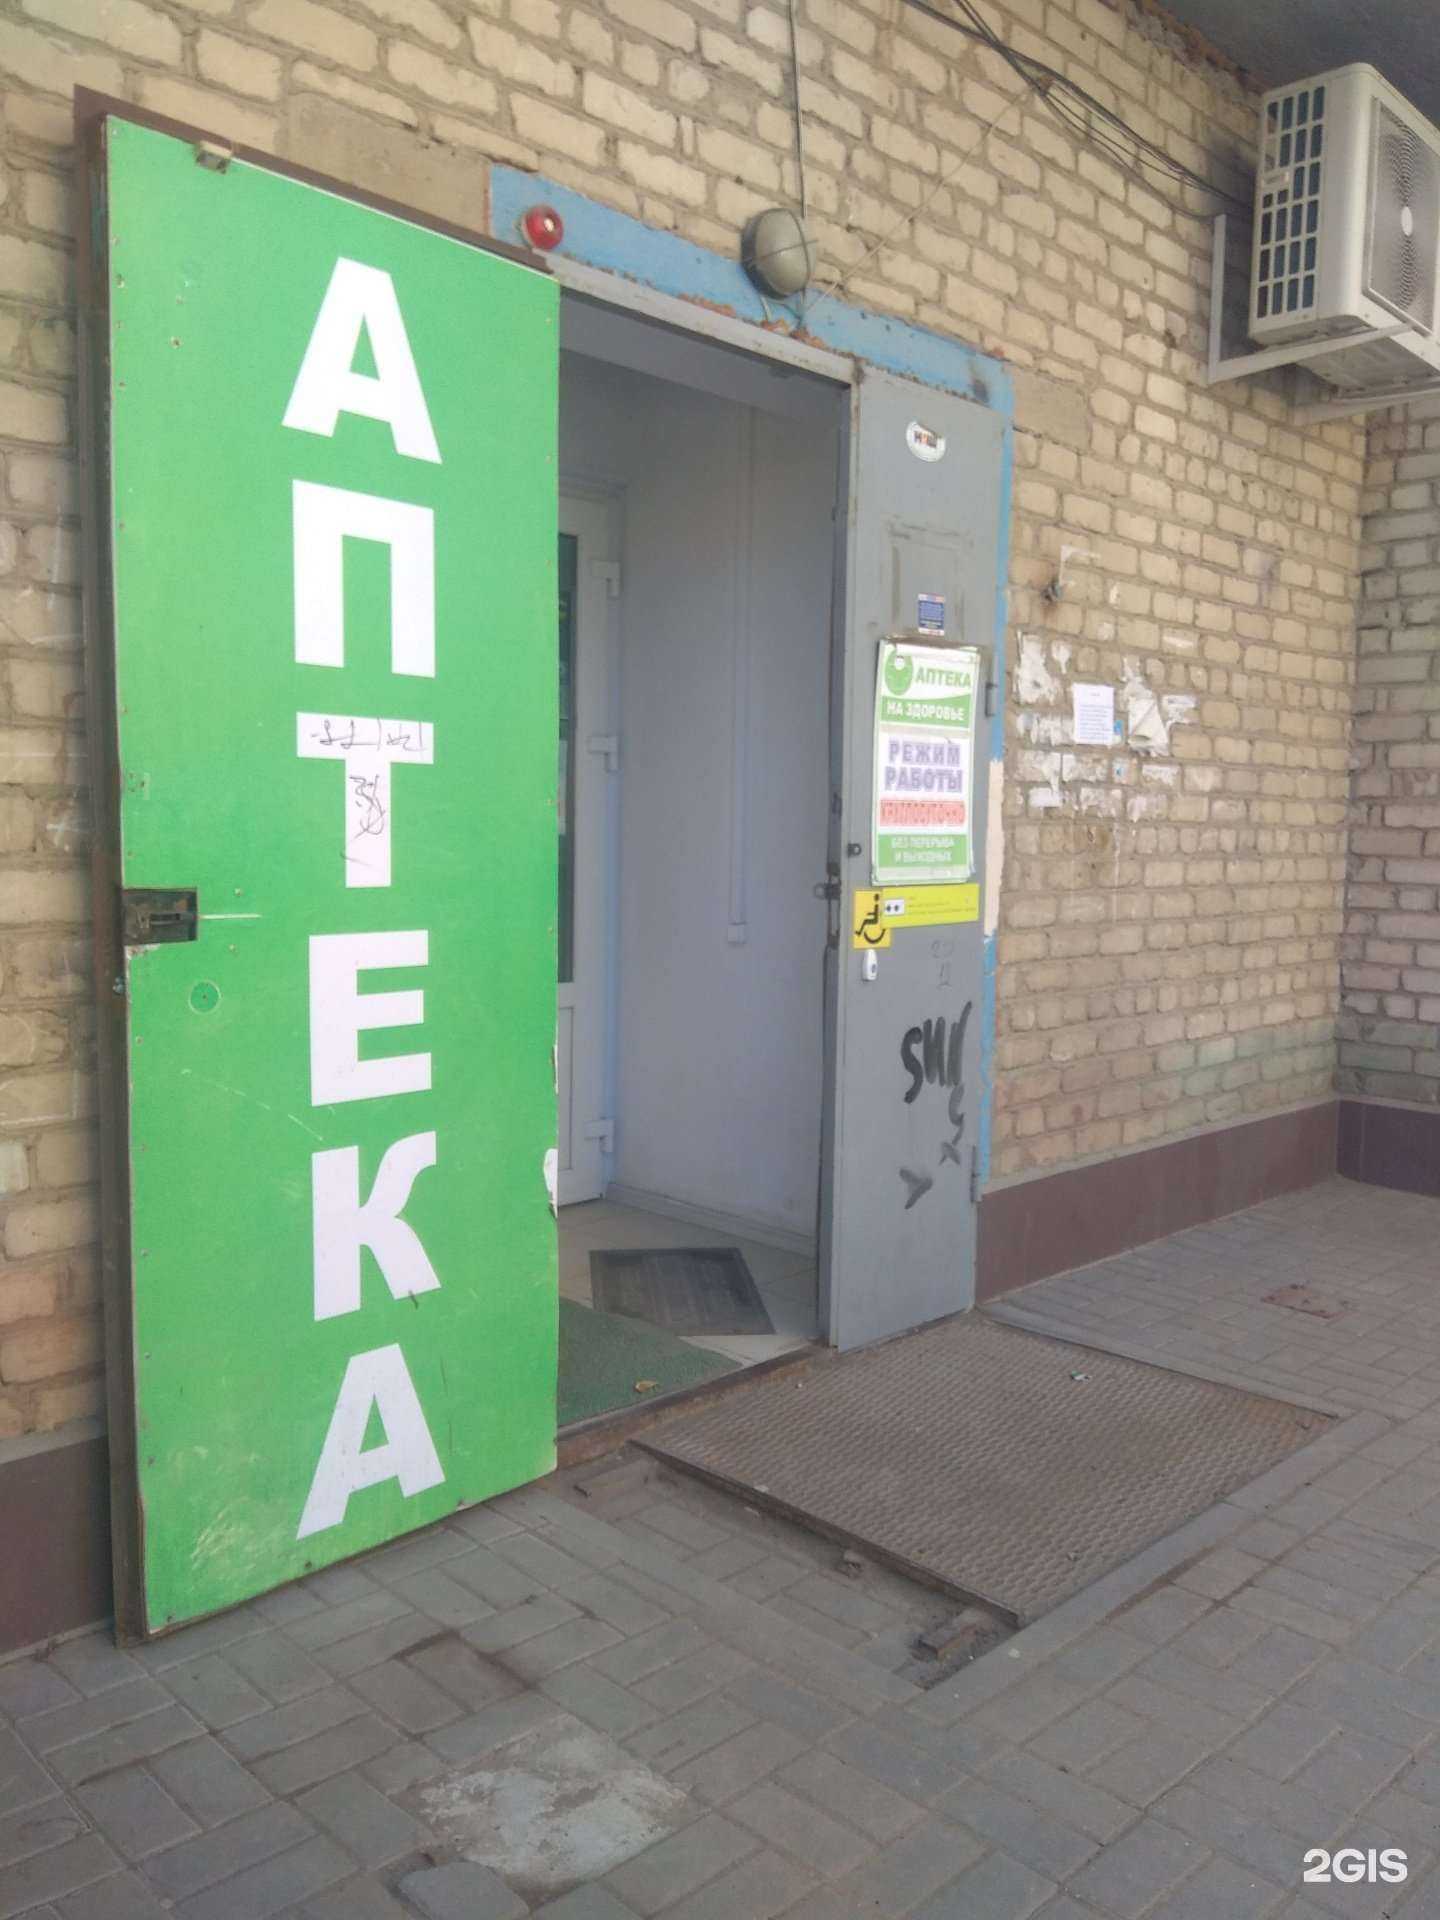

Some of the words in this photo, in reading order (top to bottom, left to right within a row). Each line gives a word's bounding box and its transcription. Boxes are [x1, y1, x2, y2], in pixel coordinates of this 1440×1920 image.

[915, 667, 971, 688] АПТЕКА
[887, 700, 903, 716] НА
[905, 702, 964, 721] ЗДОРОВЬЕ
[888, 740, 961, 767] РЕЖИМ
[884, 766, 963, 793] РАБОТЫ
[282, 256, 446, 1541] АПТЕКА
